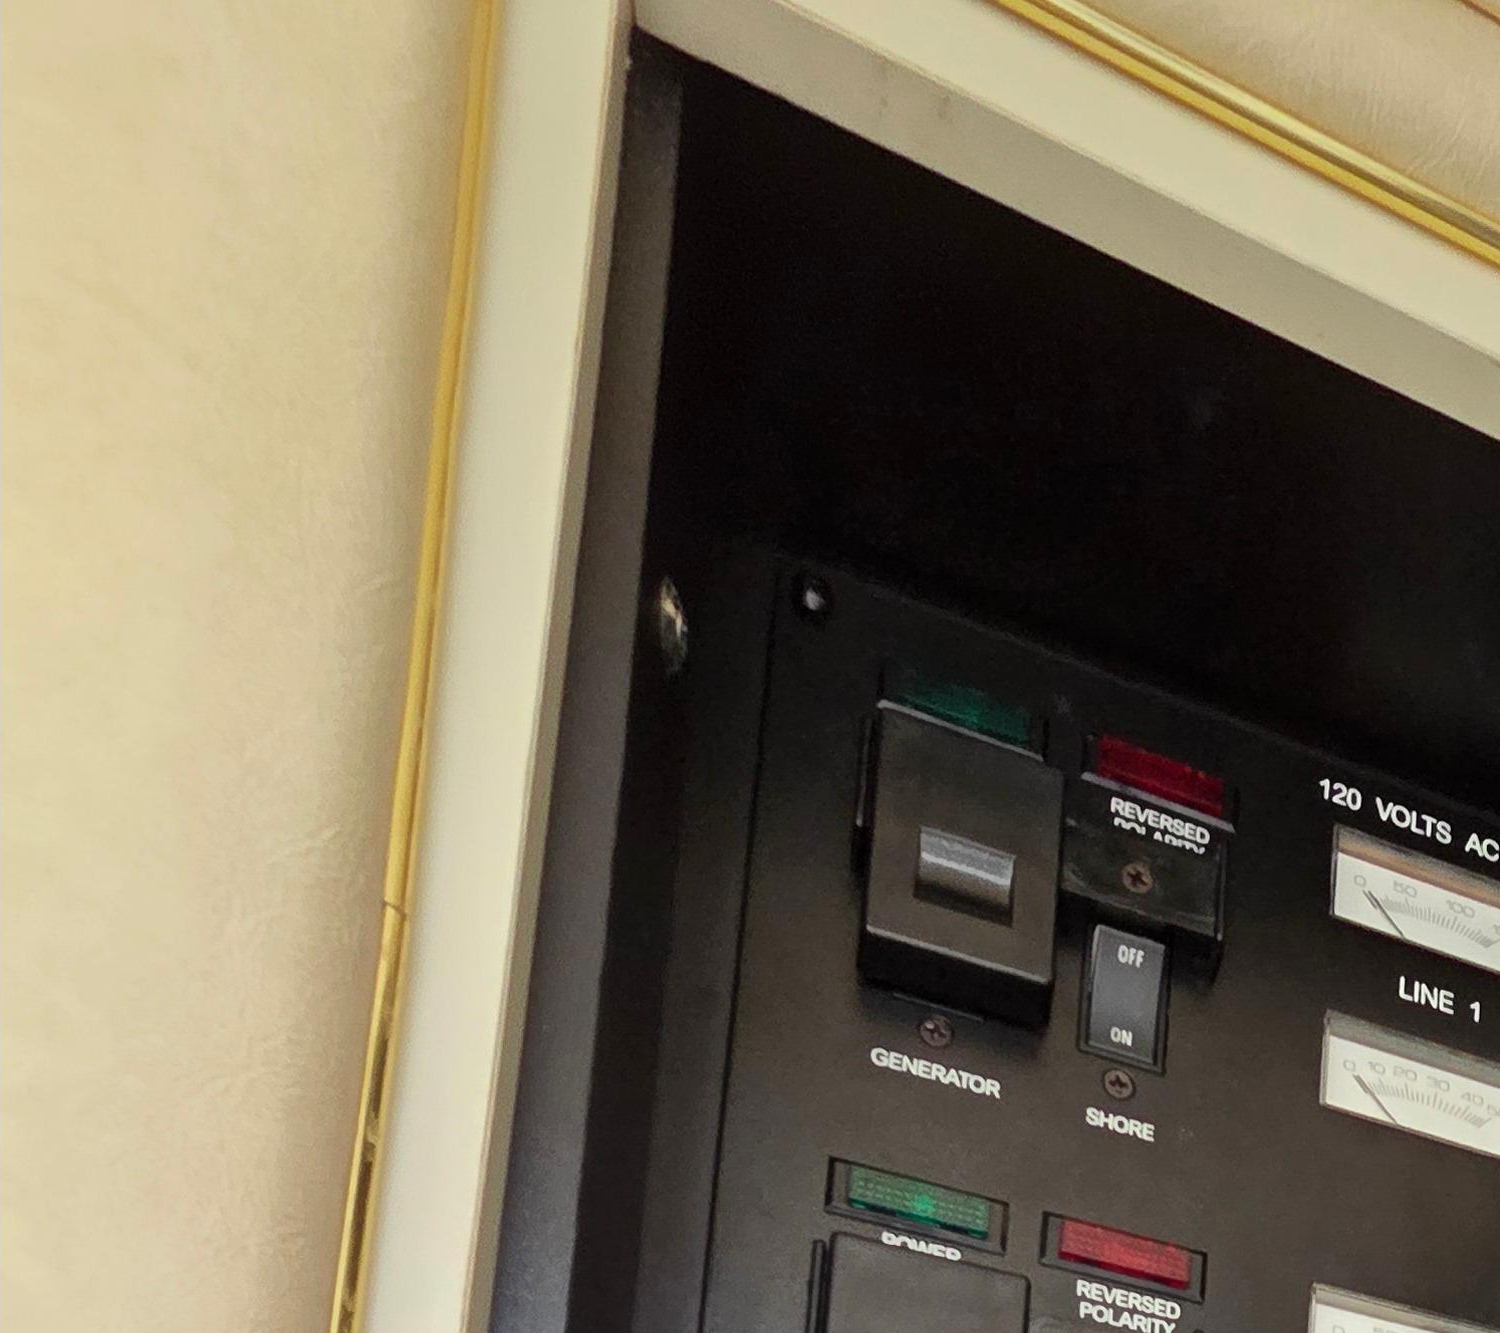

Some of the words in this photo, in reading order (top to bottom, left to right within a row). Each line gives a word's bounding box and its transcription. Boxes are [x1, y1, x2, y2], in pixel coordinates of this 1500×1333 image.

[1111, 797, 1210, 844] REVERSED
[1320, 780, 1361, 810] 120
[1376, 797, 1451, 844] VOLTS
[1465, 833, 1499, 861] AC
[1399, 976, 1454, 1014] LINE
[1470, 1002, 1480, 1022] 1
[871, 1048, 1000, 1098] GENERATOR
[1086, 1107, 1154, 1142] SHORE
[1076, 1280, 1180, 1319] REVERSED
